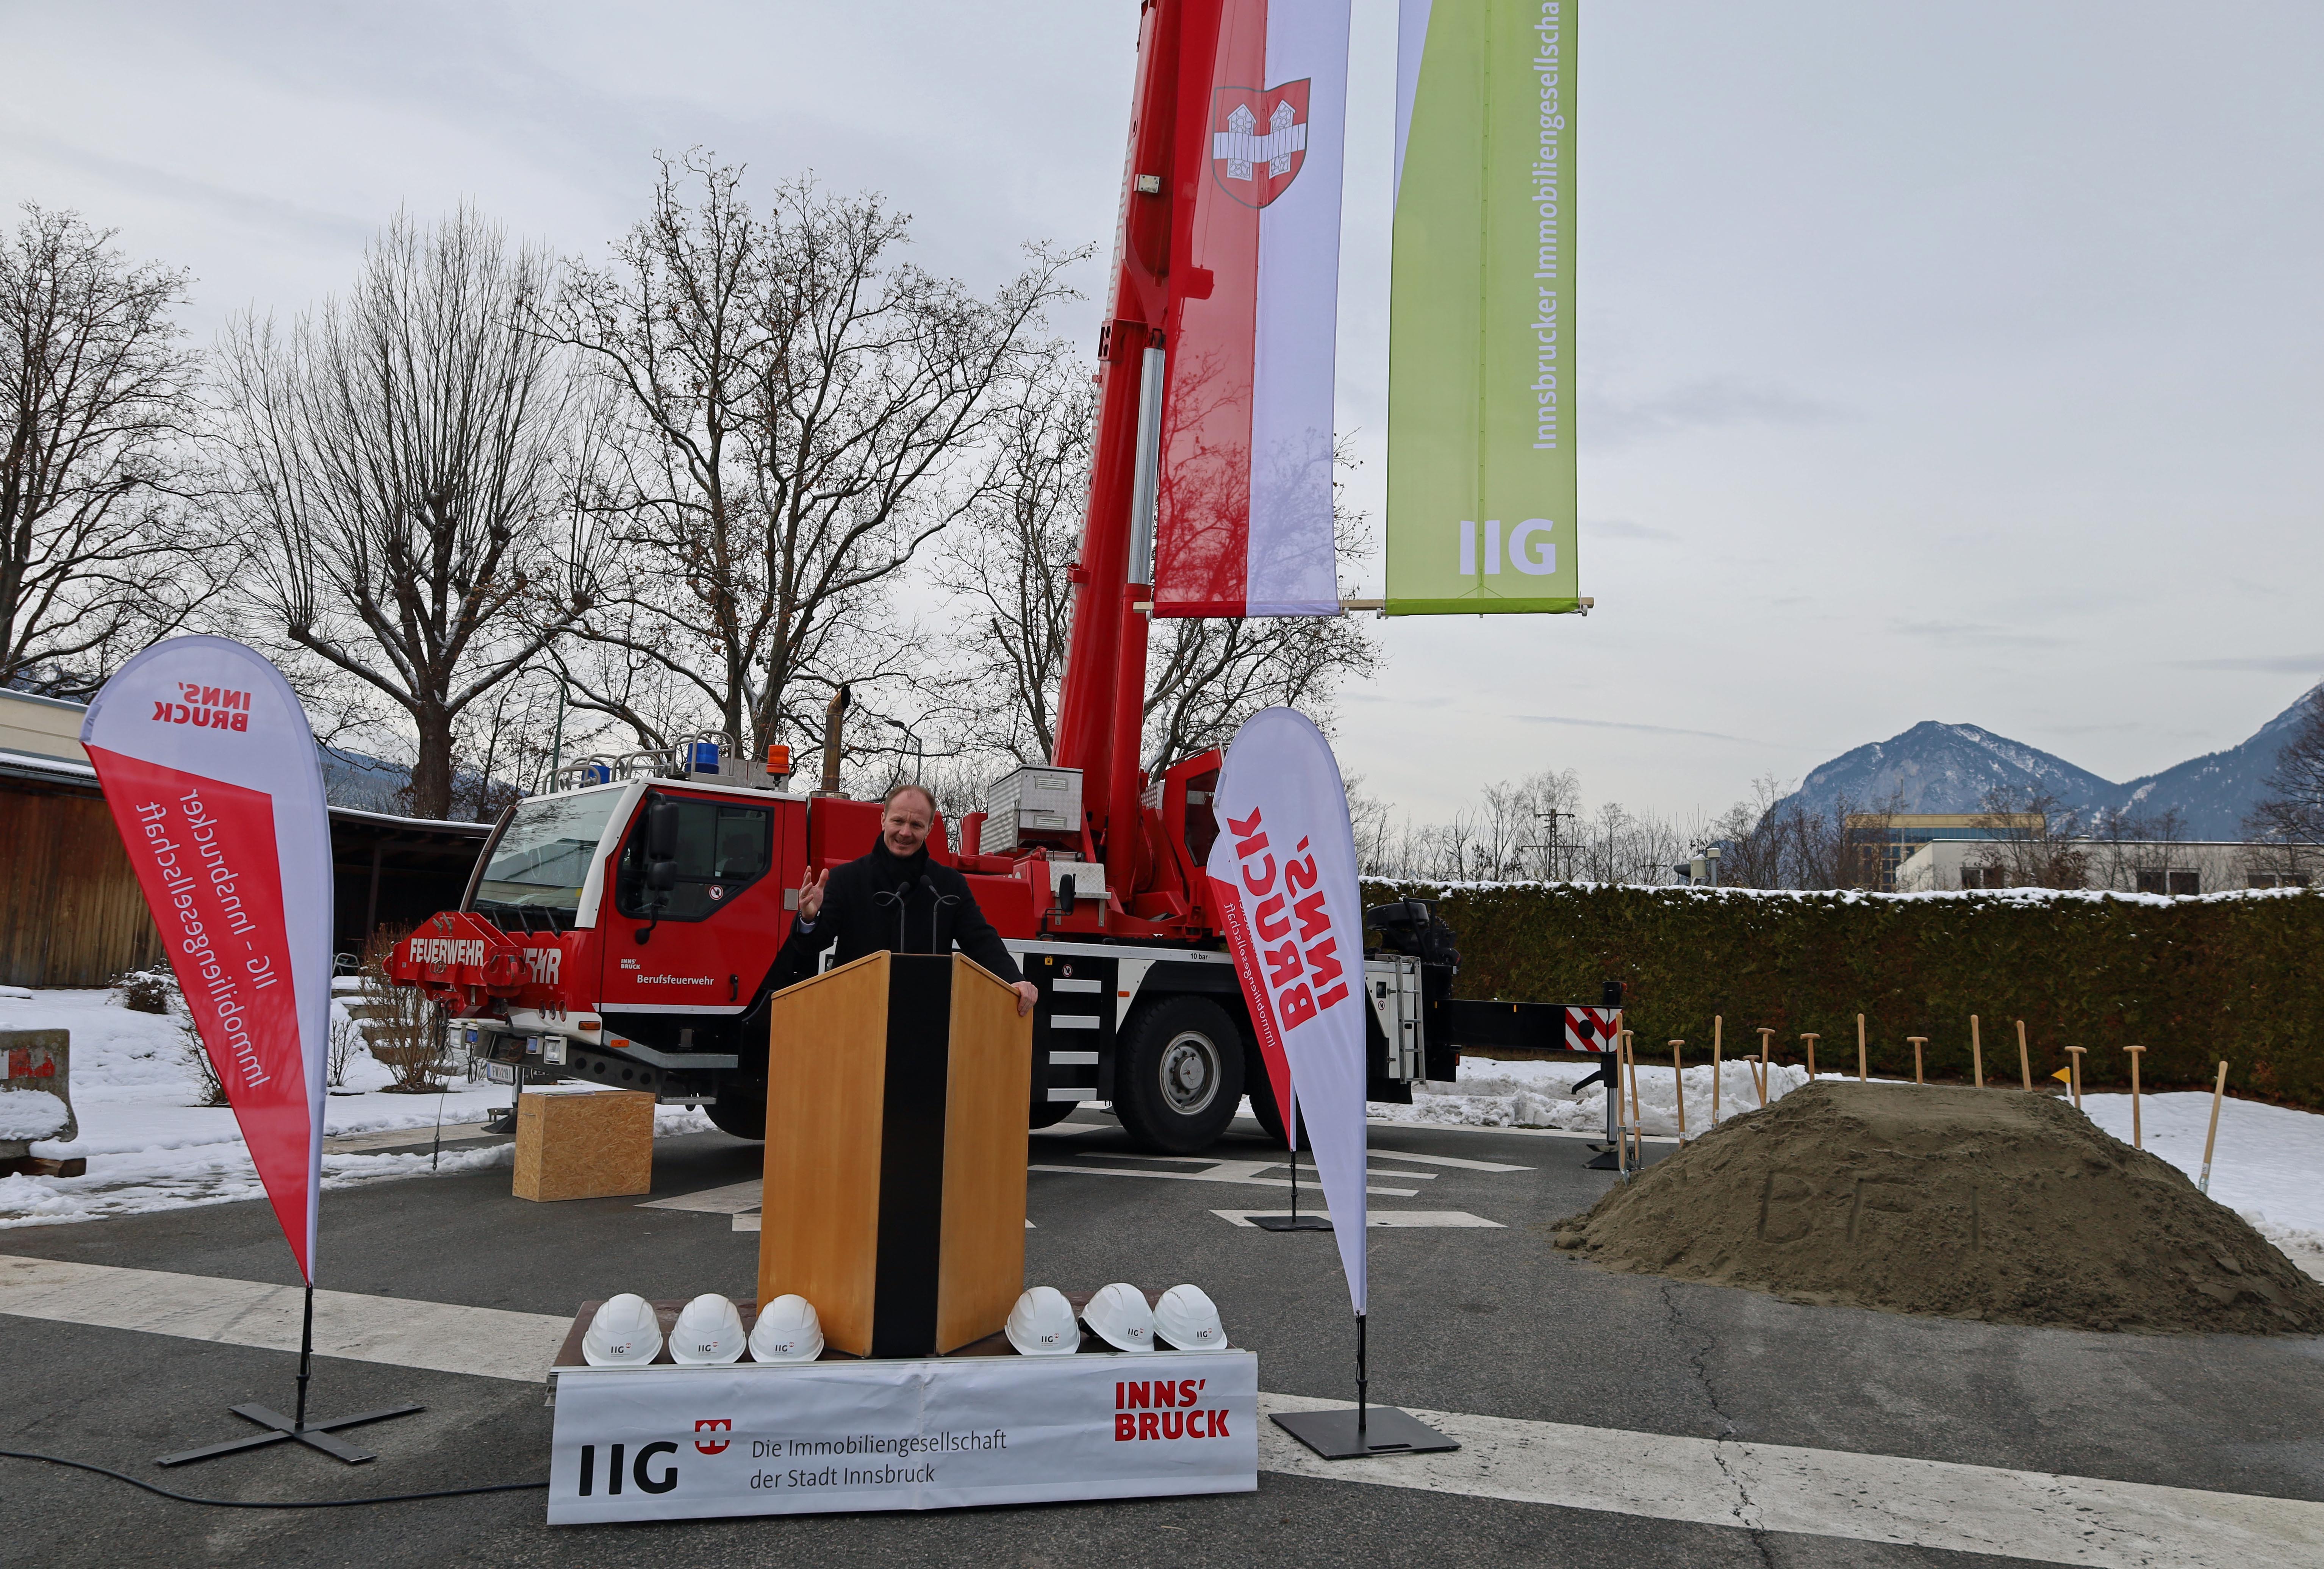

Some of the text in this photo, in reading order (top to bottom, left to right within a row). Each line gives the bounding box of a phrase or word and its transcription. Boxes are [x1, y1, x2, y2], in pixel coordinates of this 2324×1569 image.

[1531, 0, 1565, 449] Innsbrucker Immobiliengesellscha
[1460, 518, 1556, 575] IIG
[410, 938, 485, 967] FEUERWEHR
[637, 974, 714, 985] Berufsfeuerwehr
[1128, 1328, 1139, 1336] IIG
[1115, 1379, 1206, 1410] INNS'
[1115, 1409, 1230, 1442] BRUCK
[752, 1429, 1007, 1459] Die Immobiliengesellschaft
[579, 1441, 679, 1497] IIG
[750, 1463, 935, 1489] der Stadt Innsbruck
